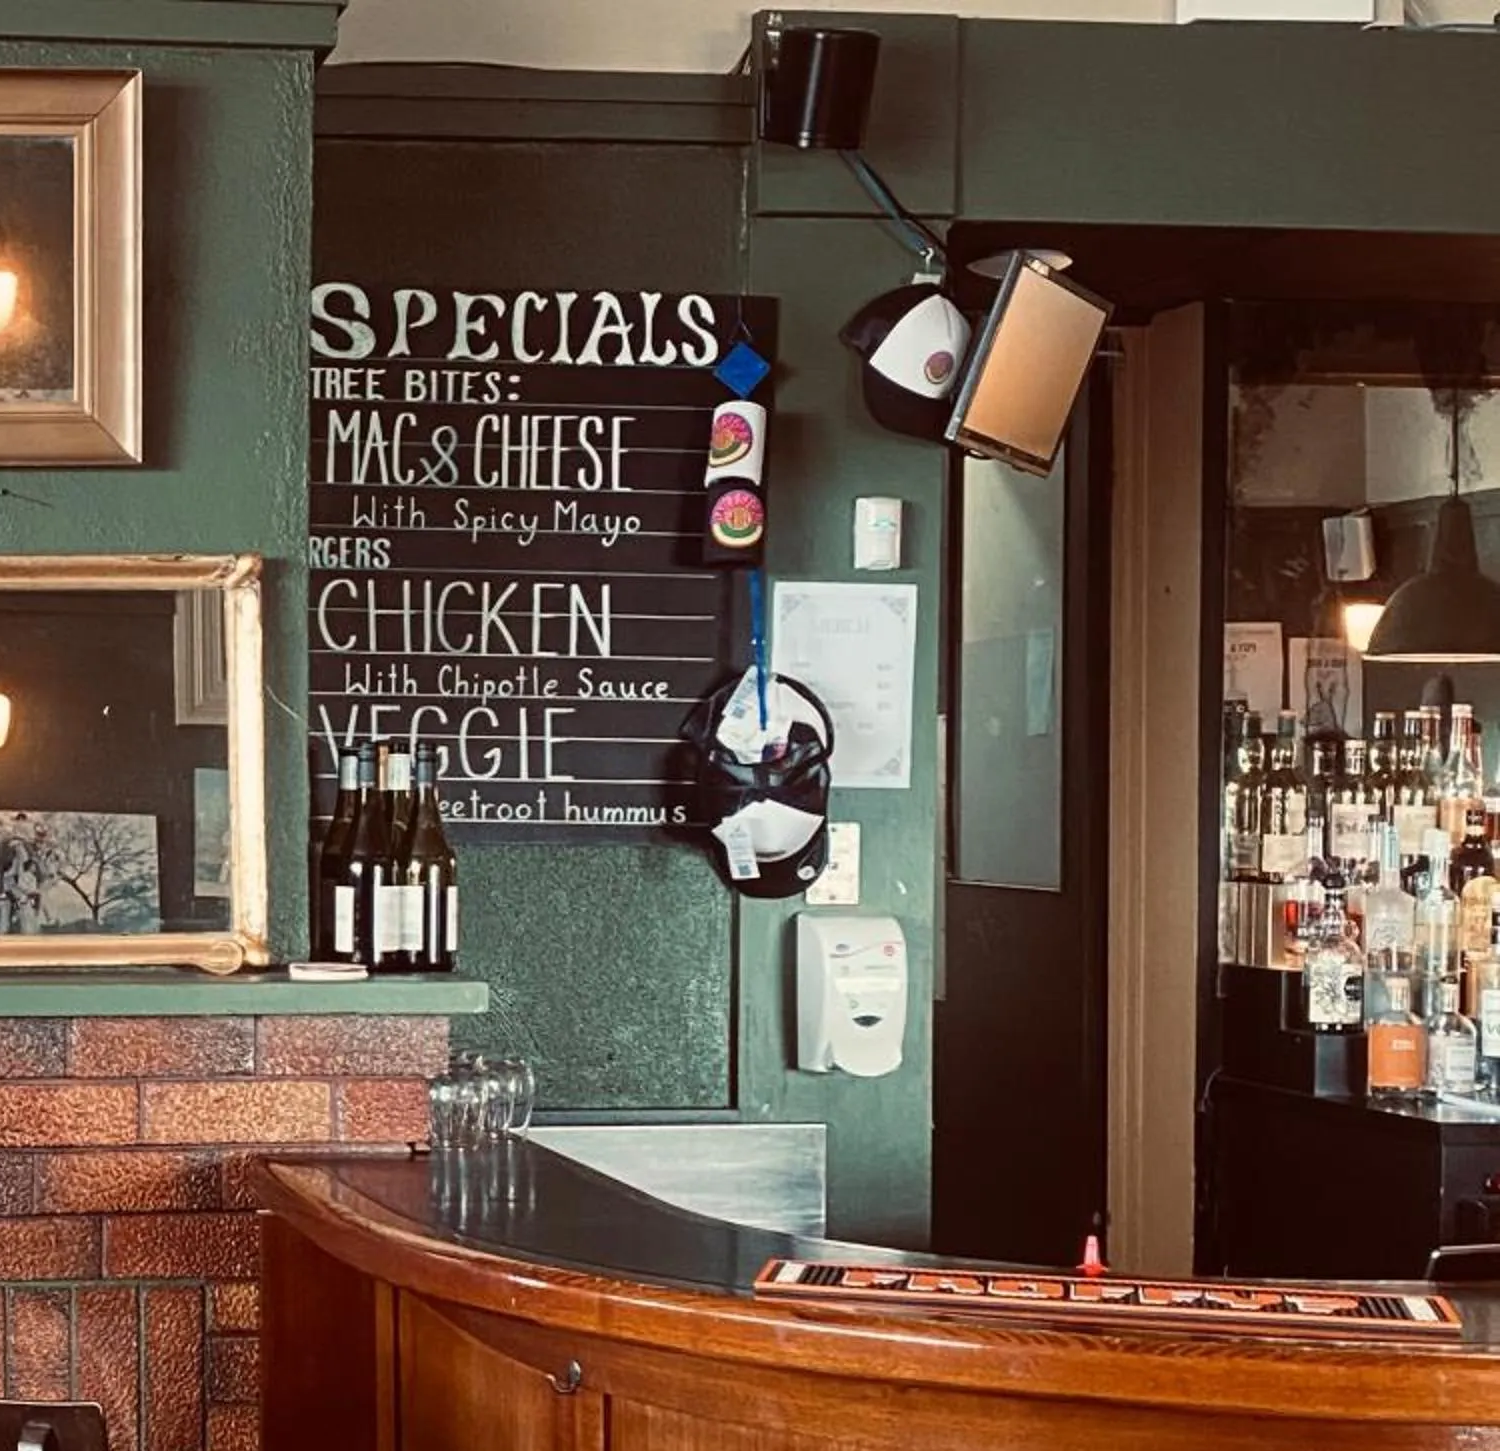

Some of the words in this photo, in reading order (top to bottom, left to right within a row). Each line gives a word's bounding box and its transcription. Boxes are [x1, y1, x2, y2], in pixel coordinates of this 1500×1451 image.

[309, 282, 719, 367] SPECIALS
[405, 368, 521, 403] BITES:
[473, 414, 637, 492] CHEESE
[352, 494, 425, 529] With
[453, 498, 539, 545] Spicy
[554, 500, 641, 547] Mayo
[308, 536, 391, 570] RGERS
[318, 578, 612, 659] CHICKEN
[345, 662, 418, 696] With
[437, 664, 559, 706] Chipotle
[578, 667, 670, 700] Sauce
[319, 704, 577, 781] VEGGIE
[439, 790, 547, 822] eetroot
[564, 790, 688, 824] hummus
